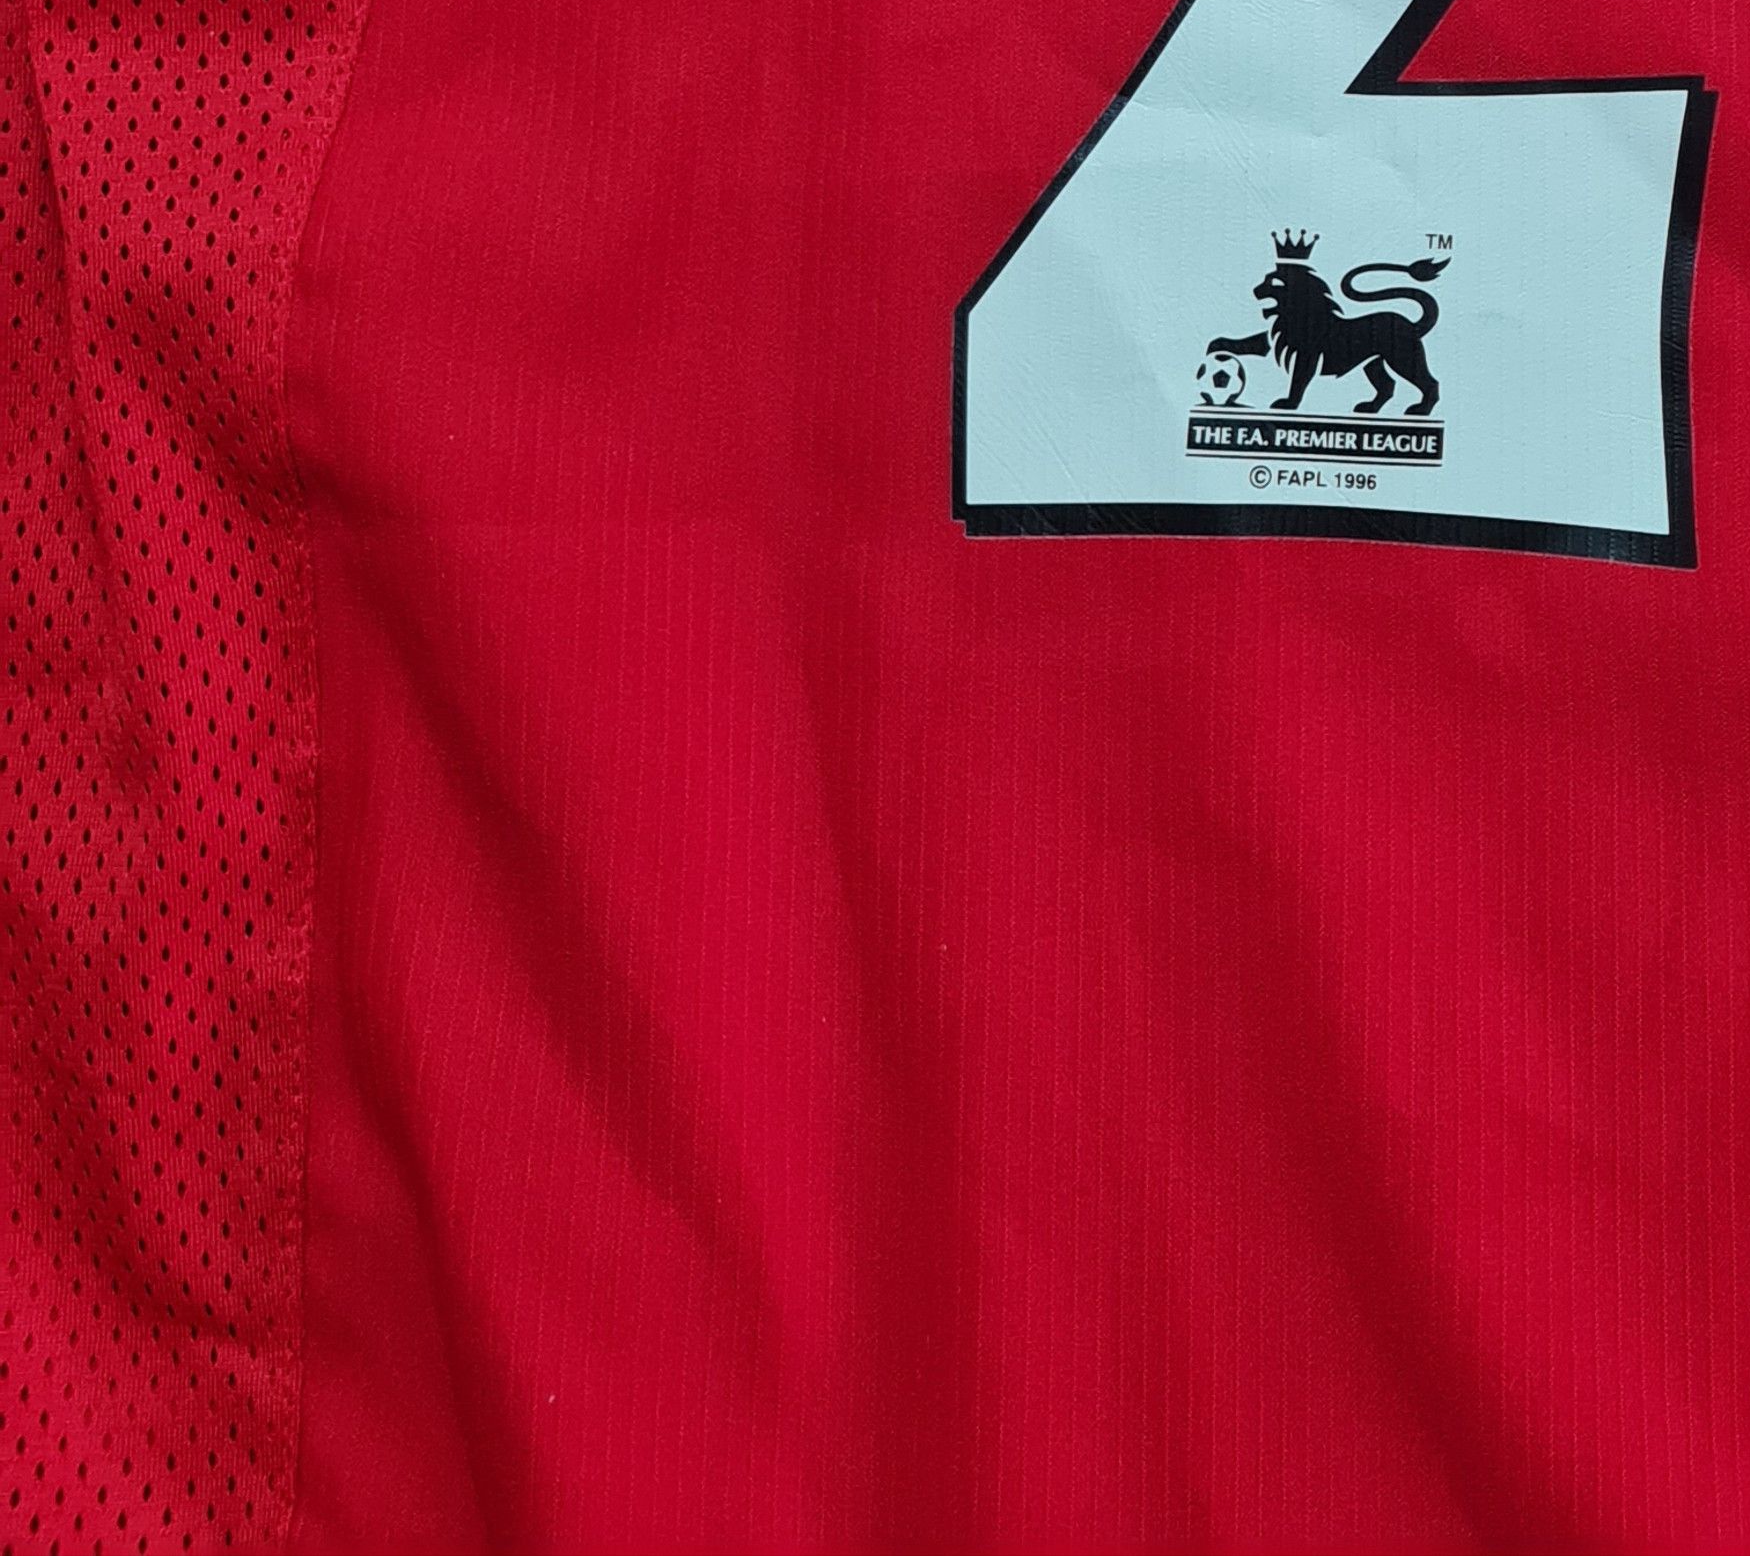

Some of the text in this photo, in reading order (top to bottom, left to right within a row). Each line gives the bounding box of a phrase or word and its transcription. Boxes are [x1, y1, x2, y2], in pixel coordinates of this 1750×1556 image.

[1425, 234, 1453, 250] TM
[1192, 425, 1437, 453] THE F.A. PREMIER LEAGUE
[1277, 470, 1327, 487] FAPL
[1334, 473, 1377, 490] 1996
